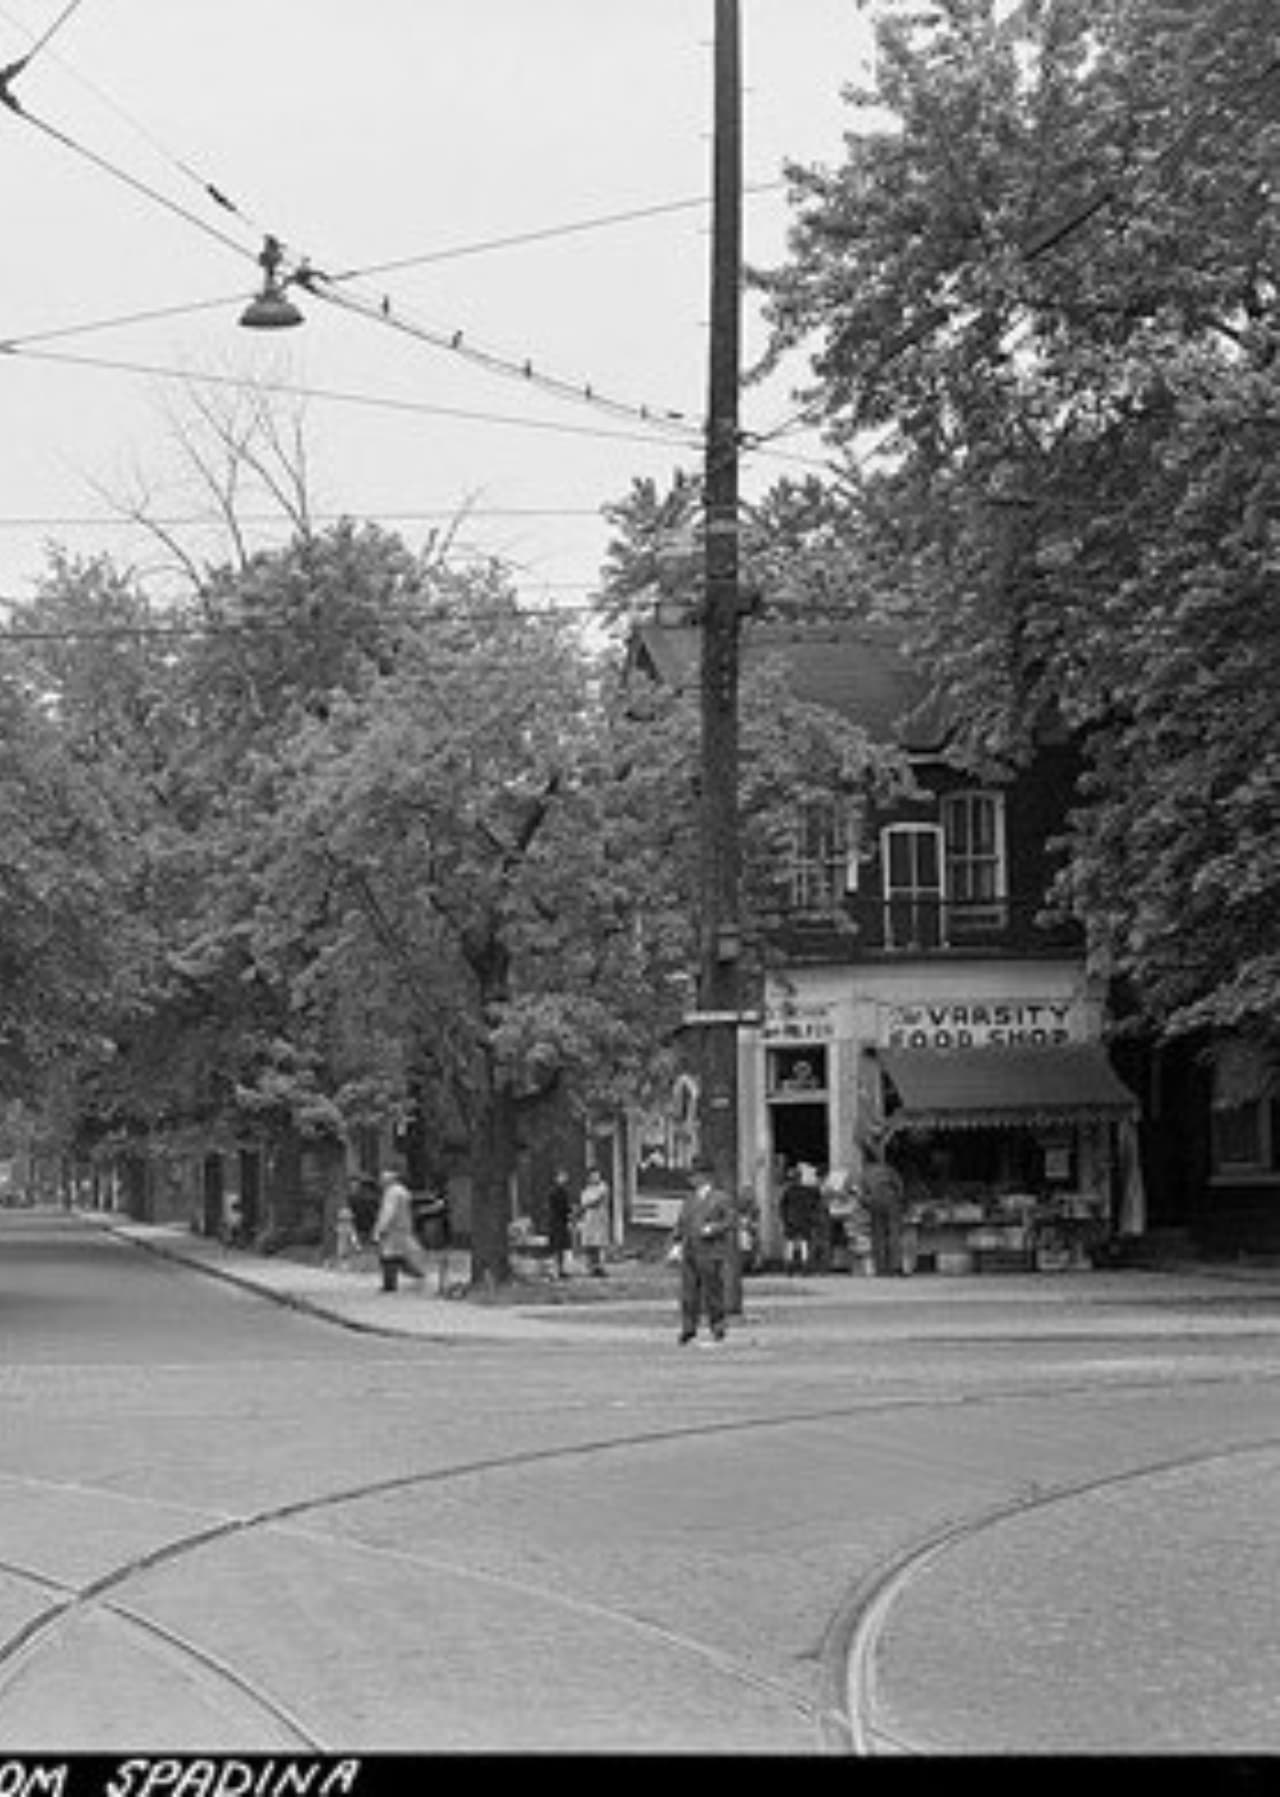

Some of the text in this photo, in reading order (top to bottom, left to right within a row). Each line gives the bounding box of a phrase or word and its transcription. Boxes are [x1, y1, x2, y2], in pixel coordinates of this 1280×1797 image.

[929, 1005, 1070, 1026] VARSITY
[889, 1028, 1069, 1049] FOOD SHOP
